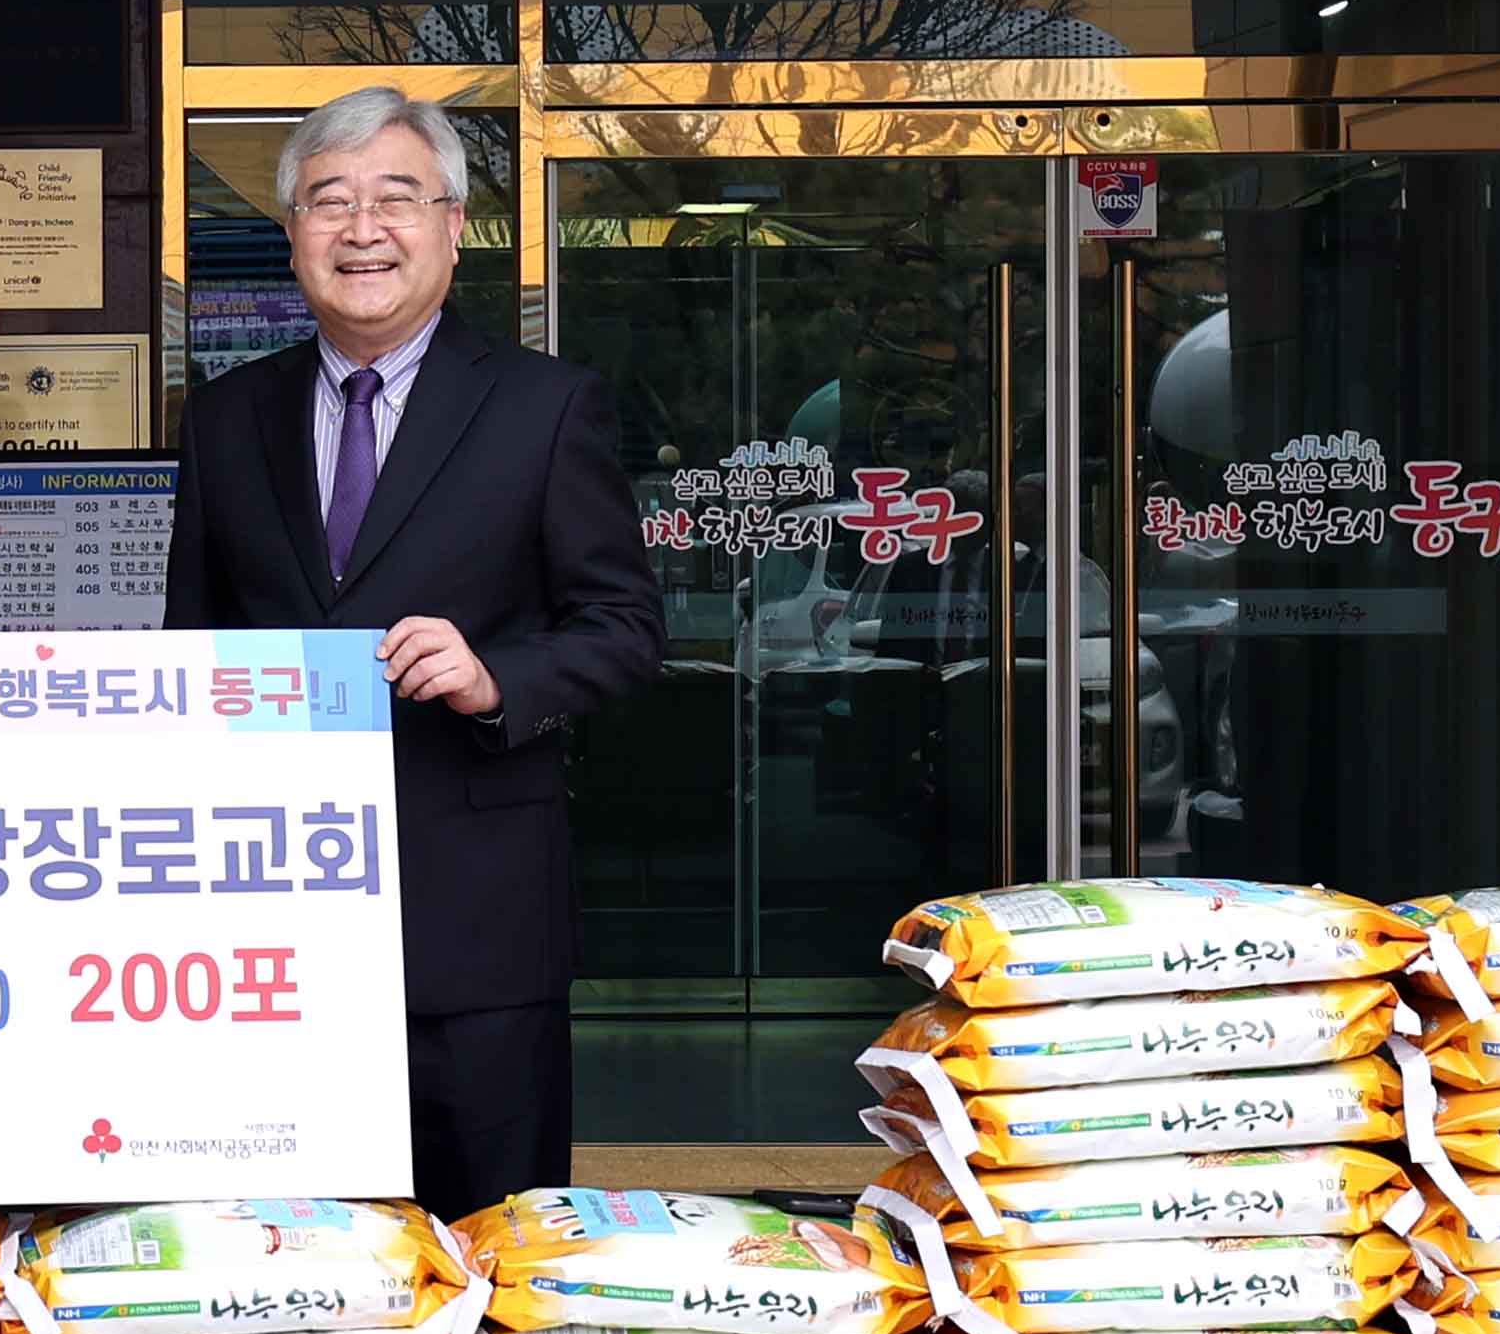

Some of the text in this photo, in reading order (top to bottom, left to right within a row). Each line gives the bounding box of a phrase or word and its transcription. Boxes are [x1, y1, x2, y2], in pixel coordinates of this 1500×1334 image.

[38, 163, 61, 172] Child
[1086, 162, 1118, 172] CCTV
[38, 173, 73, 183] Friendly
[38, 184, 62, 192] Cities
[38, 194, 77, 202] Initiative
[1098, 194, 1138, 209] BOSS
[45, 218, 74, 227] Incheon
[3, 275, 31, 285] unicef
[4, 419, 15, 430] to
[18, 419, 56, 433] certify
[58, 419, 80, 430] that
[42, 473, 171, 489] INFORMATION
[726, 468, 775, 500] 싶은
[778, 468, 835, 499] 도시!
[1276, 462, 1328, 494] 싶은
[1329, 462, 1387, 492] 도시!
[75, 501, 99, 513] 503
[699, 504, 831, 559] 행복도시
[837, 467, 984, 564] 동구
[75, 521, 100, 533] 505
[1141, 496, 1247, 552] 활기찬
[1251, 498, 1385, 553] 행복도시
[75, 543, 100, 555] 403
[75, 563, 100, 575] 405
[76, 583, 101, 595] 408
[68, 947, 301, 1023] 200포
[129, 1138, 162, 1158] 인천
